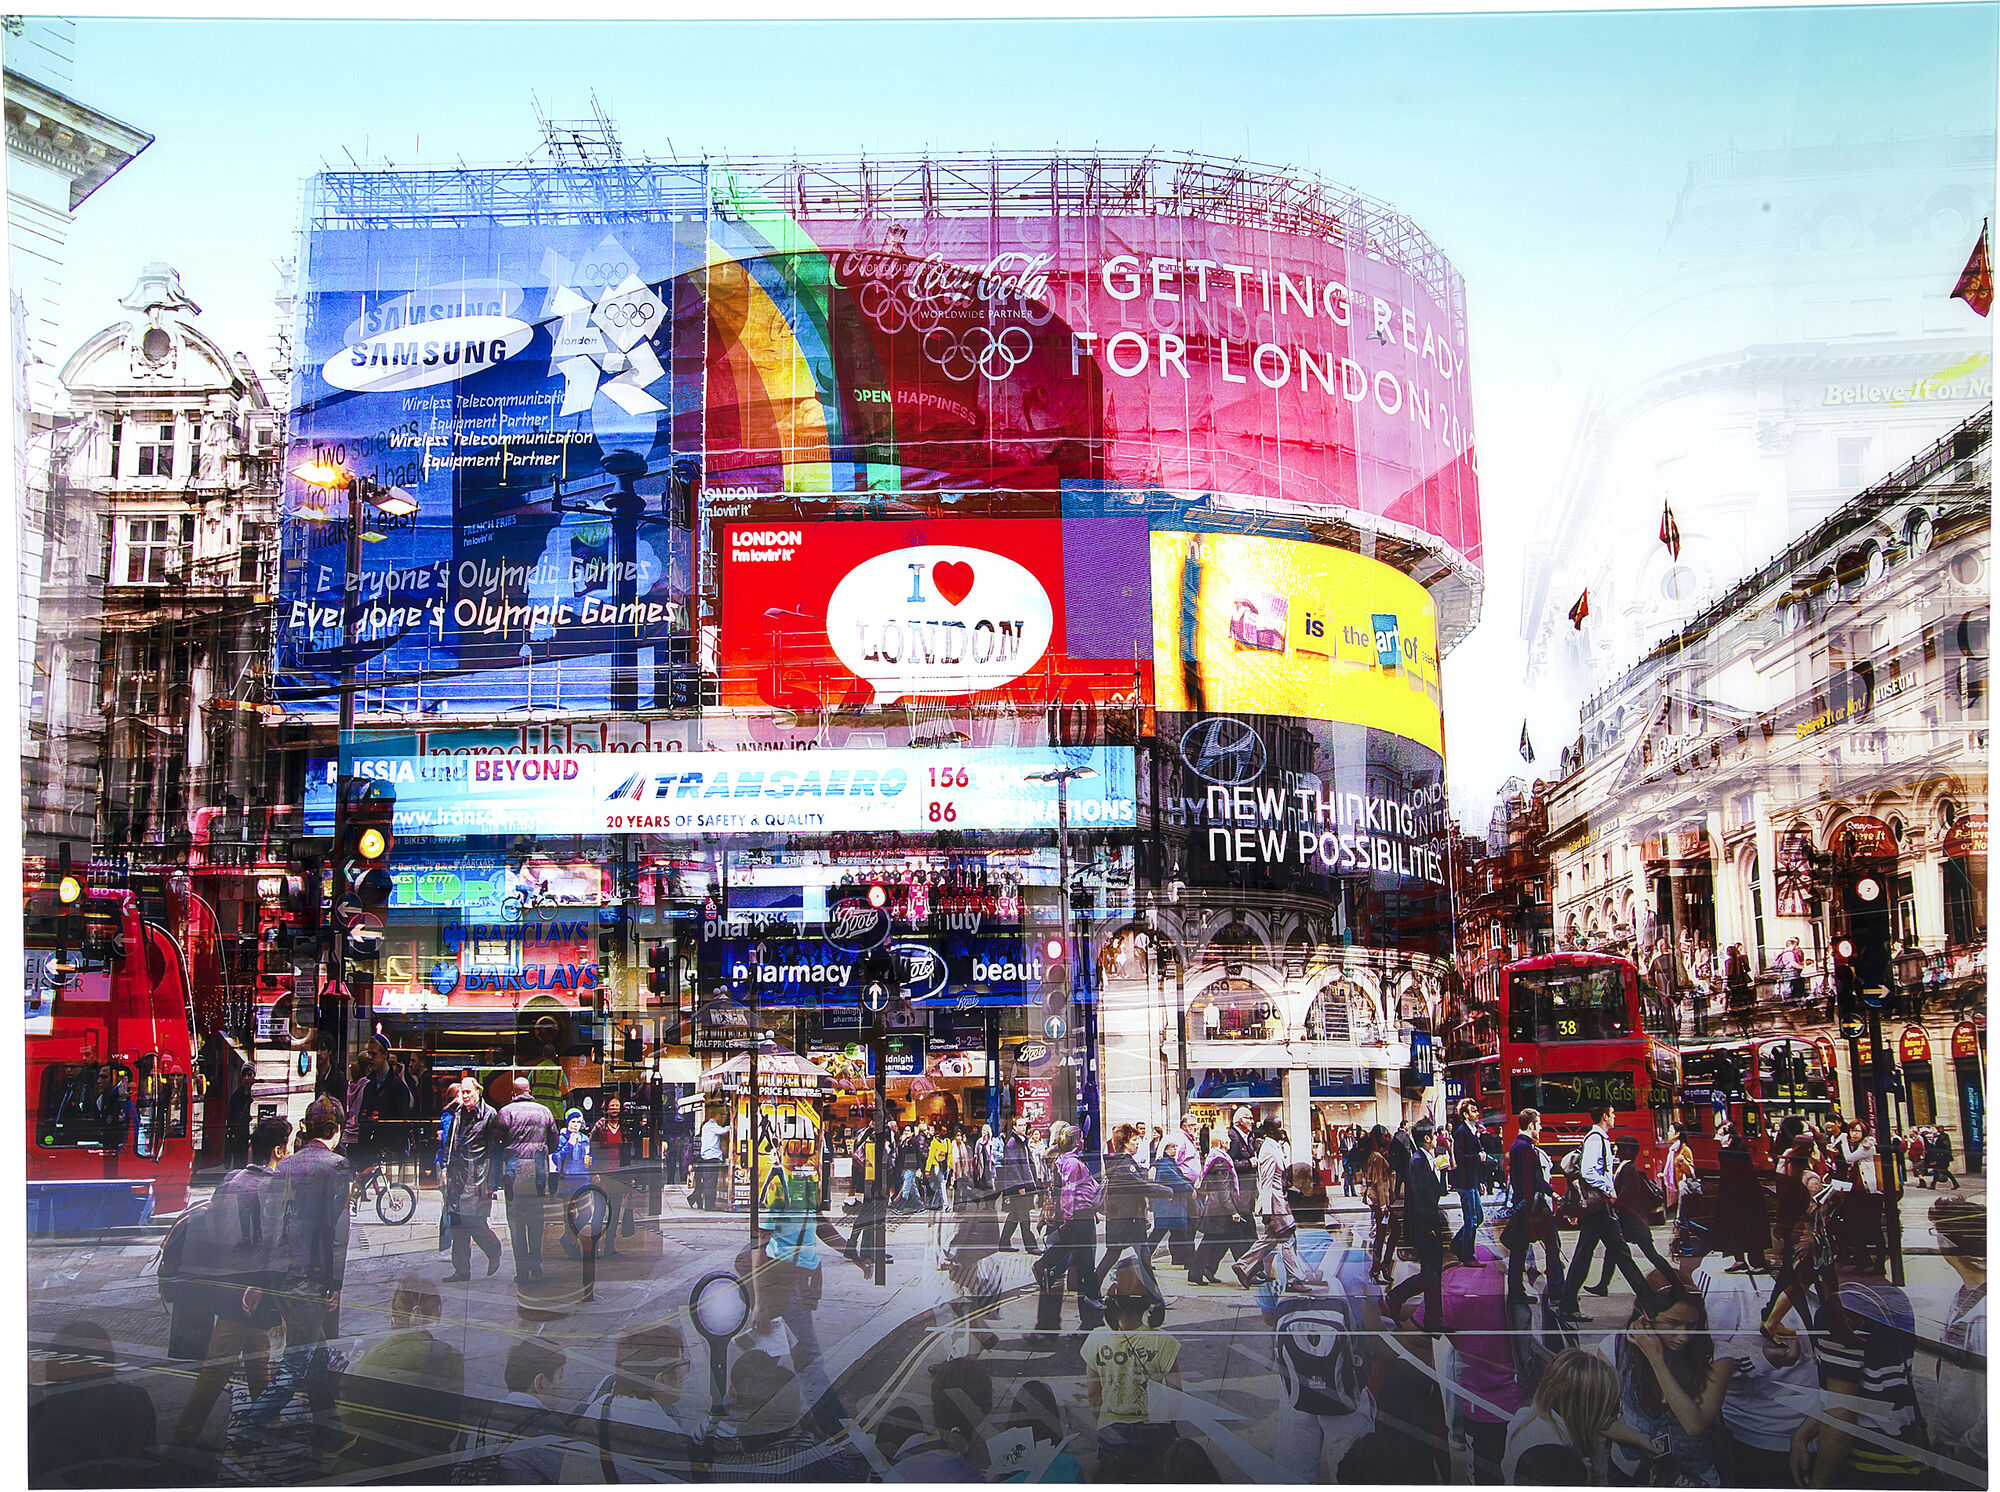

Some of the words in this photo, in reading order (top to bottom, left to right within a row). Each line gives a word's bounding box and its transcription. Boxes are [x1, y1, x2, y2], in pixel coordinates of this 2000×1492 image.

[920, 309, 985, 320] WORLDWIDE
[988, 309, 1033, 319] PARTNER
[1103, 254, 1351, 328] GETTING
[1373, 296, 1465, 393] READY
[561, 335, 598, 345] london
[350, 339, 507, 368] SAMSUNG
[1072, 330, 1192, 380] FOR
[1221, 338, 1432, 431] LONDON
[1823, 381, 1904, 406] Believe
[1912, 379, 1932, 398] It
[1936, 382, 1961, 398] or
[402, 394, 453, 412] Wireless
[853, 389, 891, 403] OPEN
[897, 390, 977, 426] HAPPINESS
[430, 413, 497, 435] Equipment
[500, 412, 549, 428] Partner
[390, 430, 450, 448] Wireless
[453, 428, 594, 448] Telecommunication
[313, 443, 346, 469] Two
[423, 452, 502, 473] Equipment
[503, 452, 561, 469] Partner
[385, 453, 426, 489] back
[495, 513, 517, 529] FRIES
[732, 530, 802, 547] LONDON
[316, 559, 451, 602] Eeryone's
[457, 557, 560, 597] Olympic
[568, 557, 652, 593] Games
[907, 563, 926, 603] I
[453, 597, 572, 636] Olympic
[580, 594, 680, 626] Games
[856, 619, 1024, 665] LONDON
[1305, 613, 1325, 638] is
[1342, 624, 1370, 649] the
[1376, 624, 1402, 653] art
[1404, 635, 1418, 664] of
[1796, 714, 1827, 740] Believe
[1873, 671, 1918, 704] MUSEUM
[326, 760, 415, 784] RSSIA
[475, 759, 579, 781] BEYOND
[654, 767, 908, 799] TRANSAERO
[928, 767, 970, 788] 156
[928, 801, 957, 822] 86
[1207, 785, 1286, 822] NEW
[606, 815, 622, 829] 20
[627, 814, 671, 829] YEARS
[675, 814, 694, 827] OF
[697, 813, 748, 827] SAFETY
[750, 813, 761, 826] &
[765, 813, 825, 828] QUALITY
[1208, 828, 1288, 864] NEW
[1298, 830, 1445, 887] POSSIBILITIES.
[473, 920, 589, 950] BARCLAYS
[830, 907, 880, 939] Boots
[464, 963, 600, 991] BARCLAYS
[1558, 1020, 1577, 1035] 38
[694, 1039, 713, 1049] HALF
[713, 1039, 733, 1049] PRICE
[1017, 1044, 1047, 1063] Boots
[758, 1072, 776, 1087] WILL
[777, 1073, 800, 1088] ROCK
[800, 1073, 818, 1088] YOU
[759, 1086, 783, 1096] PRICE
[1018, 1087, 1025, 1098] 3
[1031, 1086, 1038, 1097] 2
[1447, 1083, 1462, 1097] GAP
[1573, 1076, 1582, 1104] 9
[1587, 1085, 1600, 1100] via
[1604, 1079, 1669, 1110] Kensington
